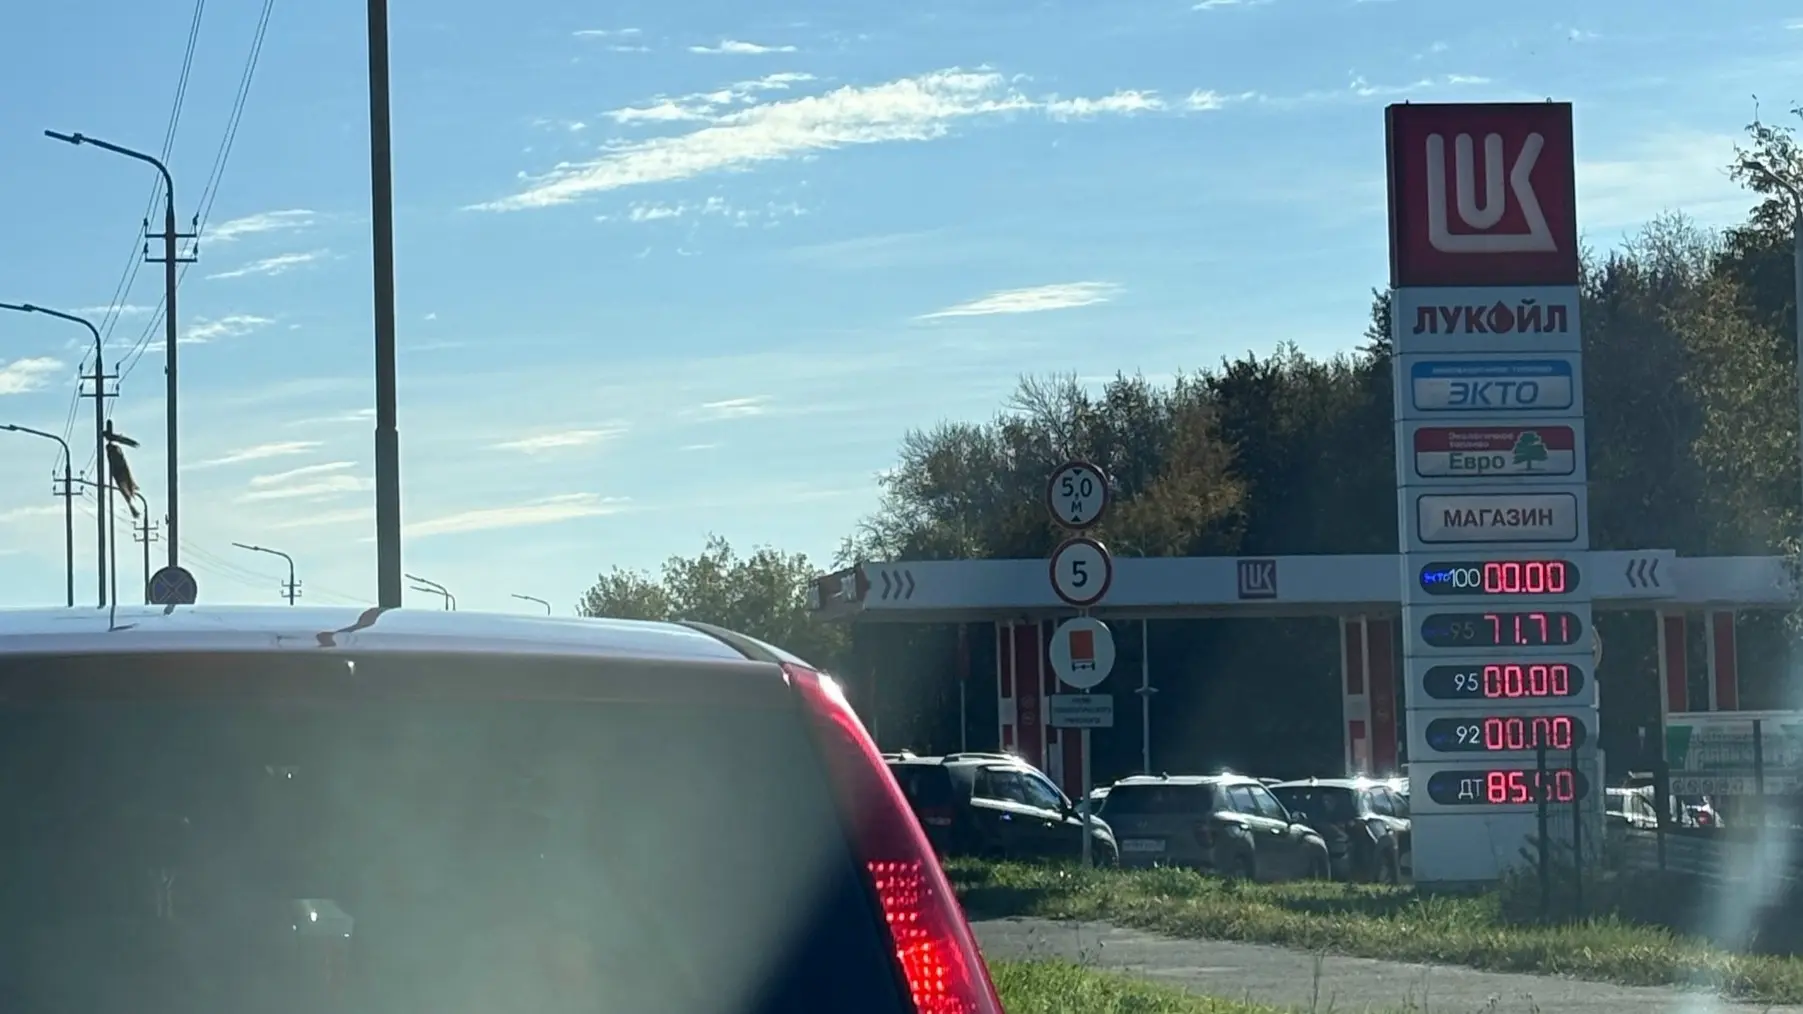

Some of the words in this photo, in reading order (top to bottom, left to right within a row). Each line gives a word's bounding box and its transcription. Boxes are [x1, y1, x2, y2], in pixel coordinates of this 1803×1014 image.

[1412, 299, 1567, 335] ЛУКОЙЛ
[1448, 380, 1539, 405] ЭКТО
[1449, 452, 1505, 473] Евро
[1062, 476, 1092, 500] 5,0
[1443, 508, 1553, 528] МАГАЗИН
[1071, 560, 1088, 588] 5
[1450, 567, 1481, 588] 100
[1484, 562, 1565, 593] 00.00
[1450, 621, 1475, 640] 95
[1484, 613, 1568, 644] 71.71
[1454, 672, 1479, 692] 95
[1484, 665, 1569, 698] 00.00
[1456, 725, 1480, 744] 92
[1458, 778, 1484, 800] ДТ
